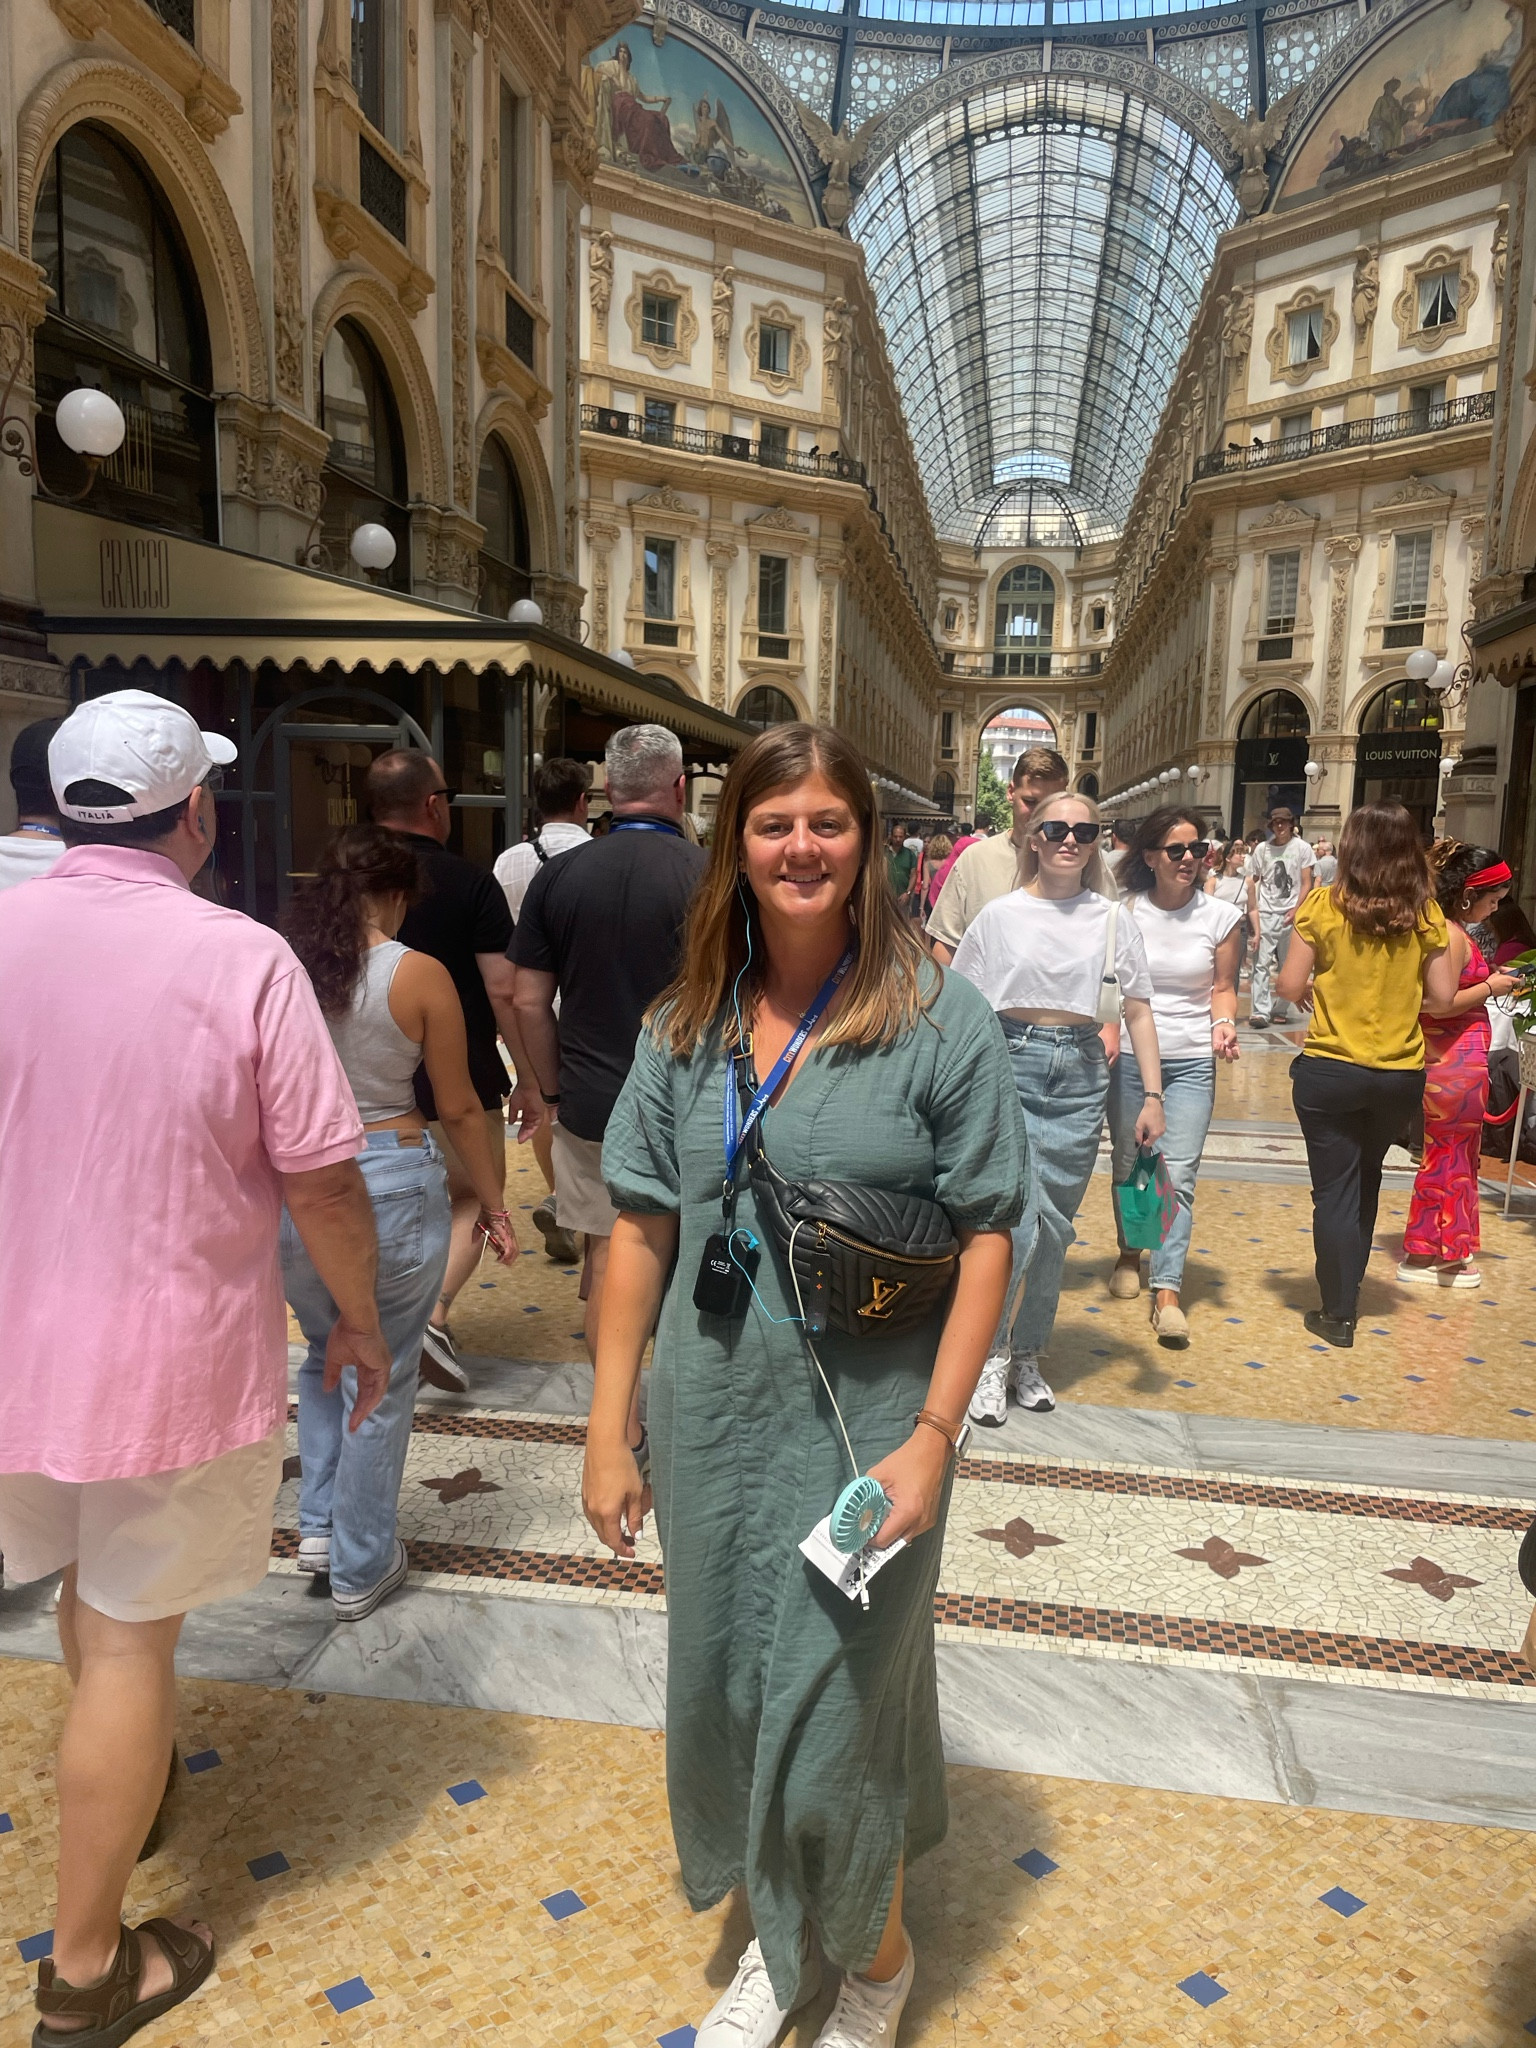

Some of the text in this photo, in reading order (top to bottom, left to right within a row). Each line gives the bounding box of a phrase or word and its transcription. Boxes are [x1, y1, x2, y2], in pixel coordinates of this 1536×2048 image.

[99, 539, 170, 609] CRACCO
[1365, 748, 1438, 761] LOUIS VUITTON
[77, 810, 115, 820] ITALIA
